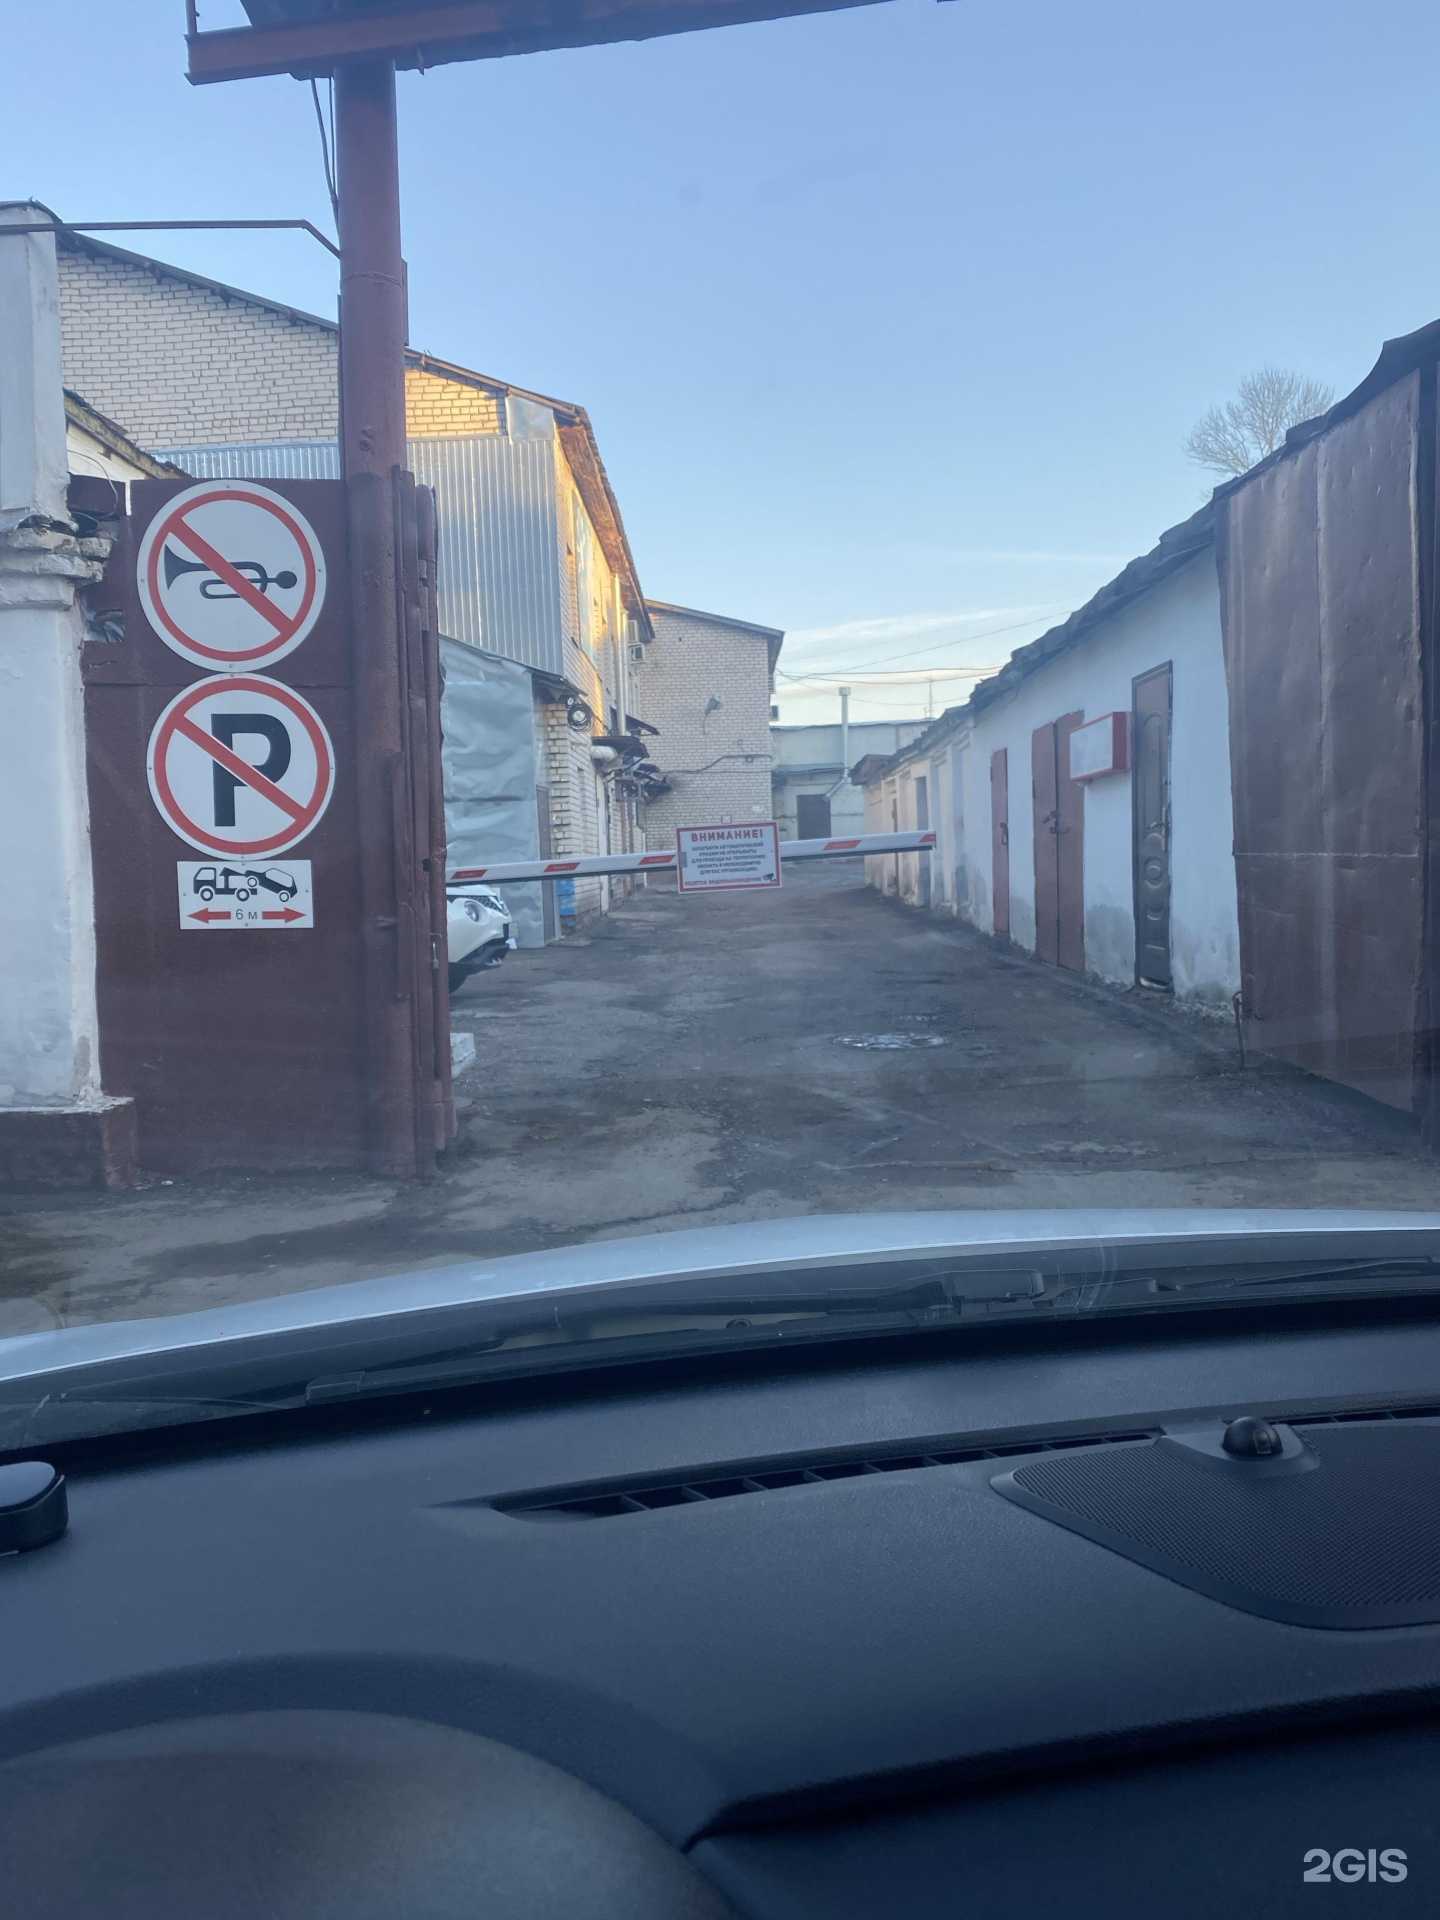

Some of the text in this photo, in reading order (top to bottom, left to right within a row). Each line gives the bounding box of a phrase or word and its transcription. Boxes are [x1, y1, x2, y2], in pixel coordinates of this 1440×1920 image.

[211, 713, 291, 827] P
[691, 829, 763, 842] ВНИМАНИЕ!
[235, 909, 244, 920] 6
